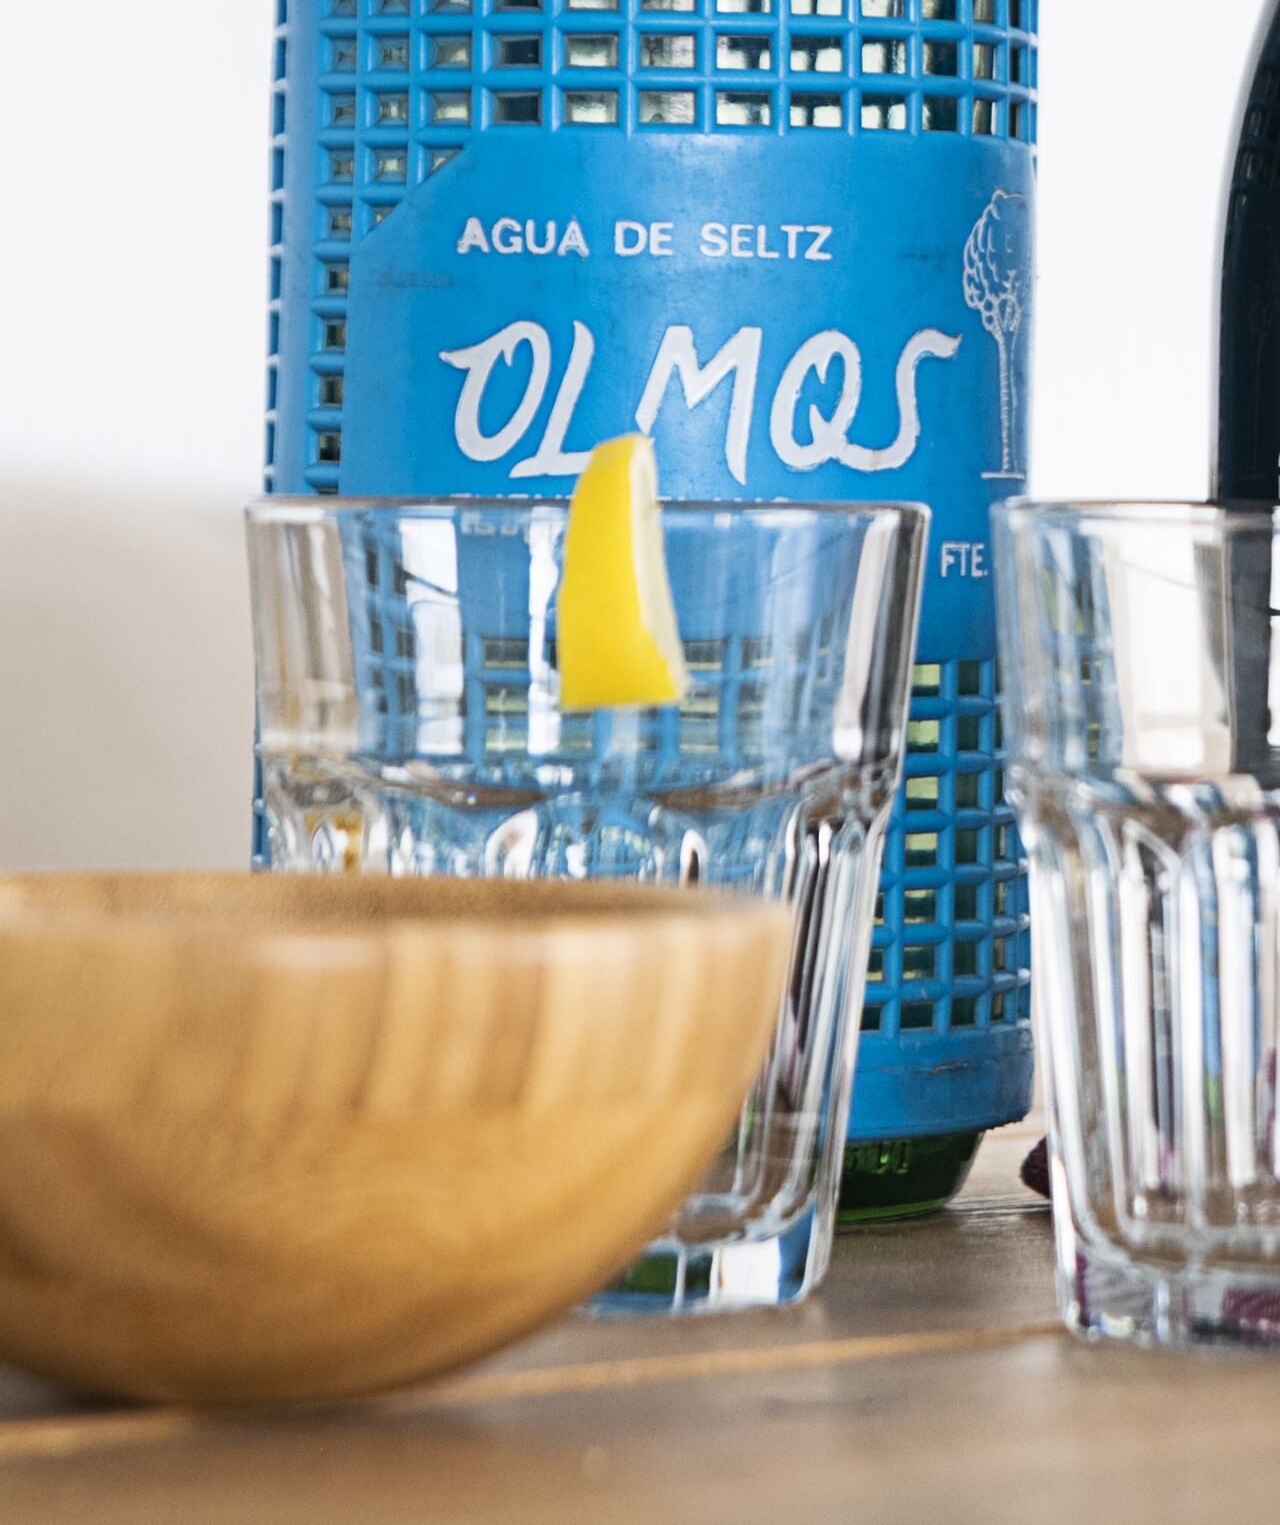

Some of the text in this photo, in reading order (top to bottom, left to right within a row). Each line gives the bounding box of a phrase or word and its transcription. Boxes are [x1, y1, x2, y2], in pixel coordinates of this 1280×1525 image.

[457, 218, 832, 260] AGUA DE SELTZ
[940, 541, 988, 578] FTE.
